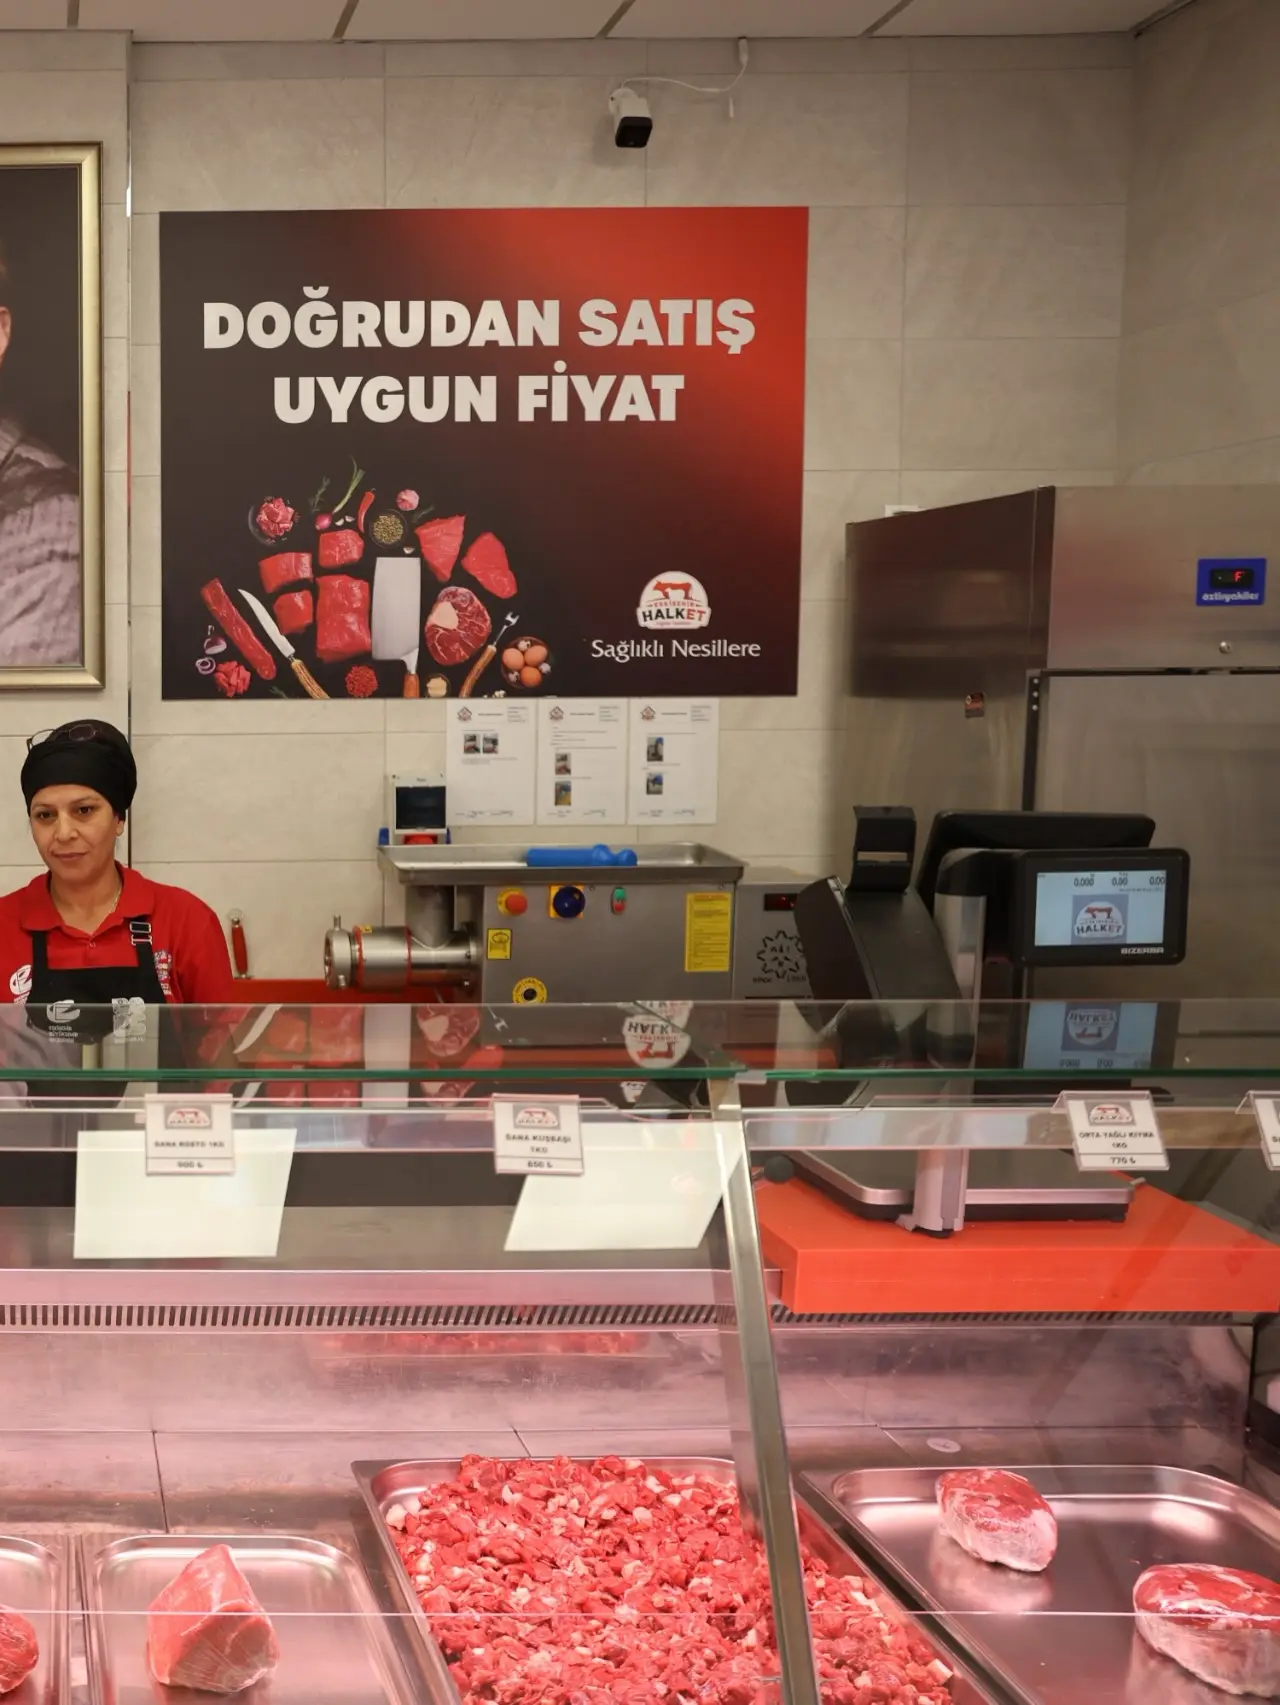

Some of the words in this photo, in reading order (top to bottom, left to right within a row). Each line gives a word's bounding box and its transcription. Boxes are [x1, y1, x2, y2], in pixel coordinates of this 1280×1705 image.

[203, 286, 560, 349] DOĞRUDAN
[578, 298, 756, 354] SATIŞ
[273, 375, 497, 424] UYGUN
[518, 360, 685, 422] FİYAT
[642, 607, 706, 623] HALKET
[591, 639, 664, 664] Sağlıklı
[671, 639, 761, 658] Nesillere
[1076, 923, 1122, 935] HALKET
